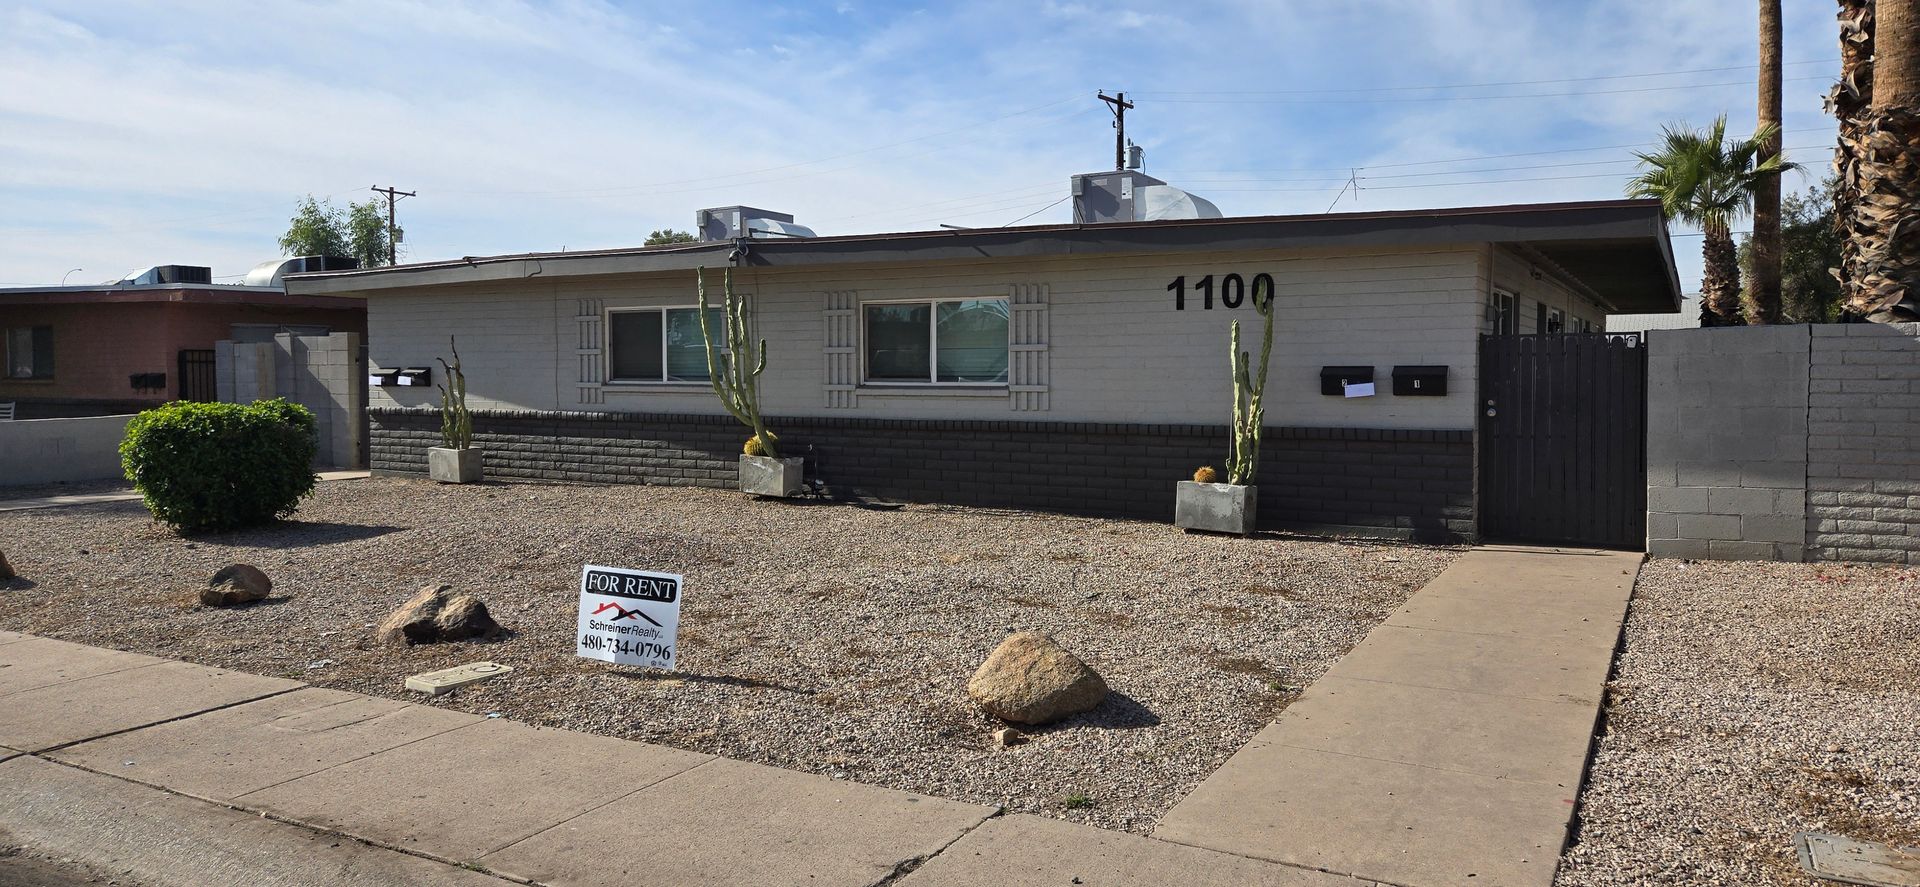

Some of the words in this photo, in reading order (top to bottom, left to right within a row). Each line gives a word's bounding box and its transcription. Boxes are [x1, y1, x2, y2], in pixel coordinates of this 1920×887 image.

[1167, 272, 1275, 311] 1100
[587, 573, 620, 593] FOR
[623, 577, 675, 599] RENT
[581, 634, 672, 661] 480-734-0796
